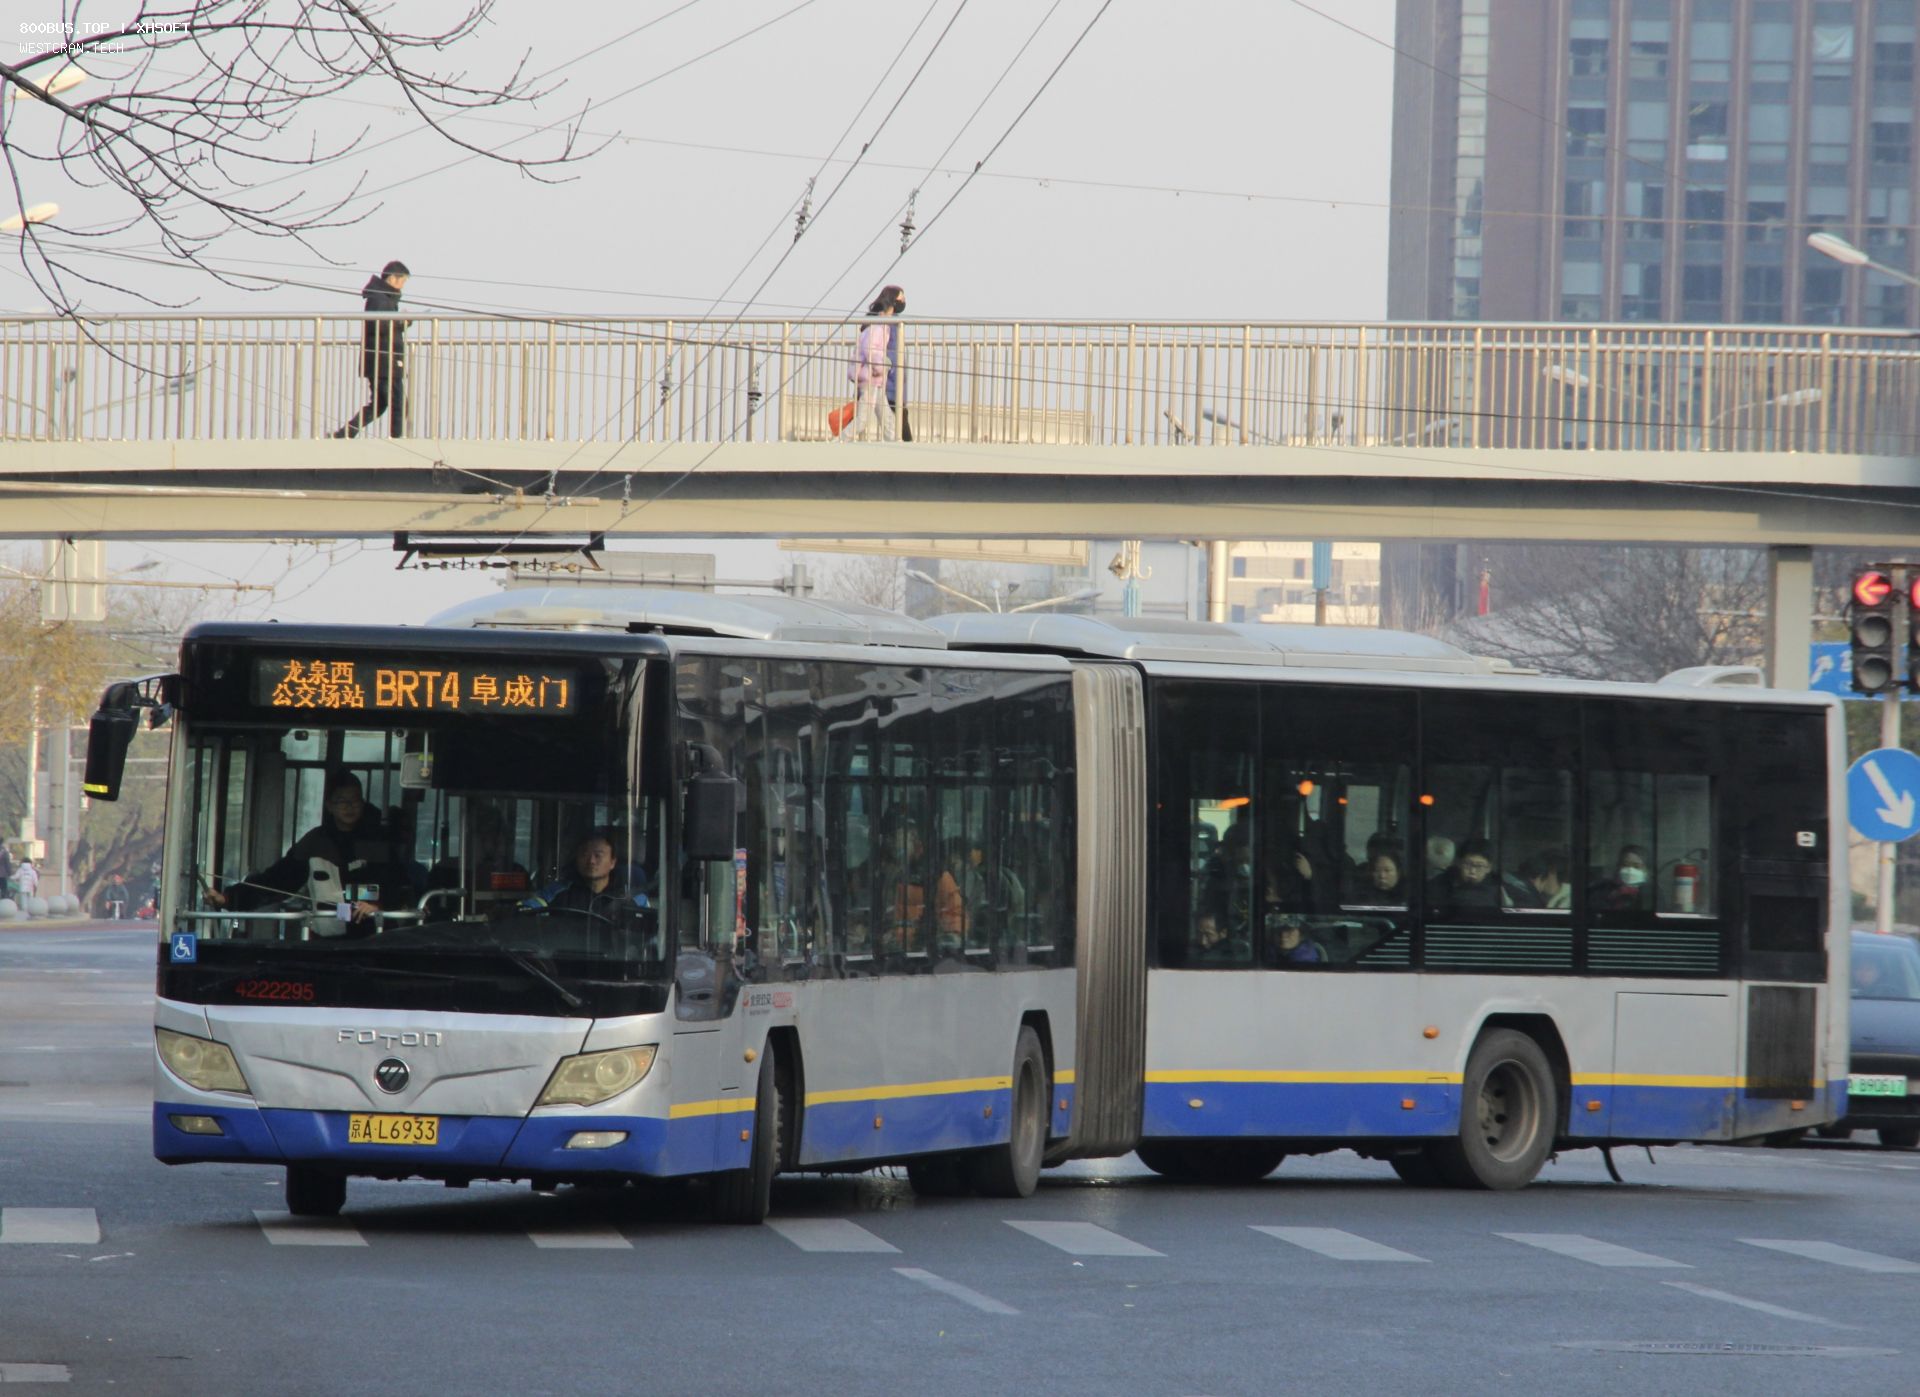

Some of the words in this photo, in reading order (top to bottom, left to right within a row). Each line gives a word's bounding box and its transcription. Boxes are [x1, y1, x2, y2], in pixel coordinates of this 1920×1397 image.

[283, 659, 354, 685] 龙泉西
[271, 683, 365, 709] 公交场站
[375, 669, 460, 709] BRT4
[469, 674, 567, 708] 阜成门
[235, 980, 315, 1001] 4222295
[337, 1028, 443, 1049] FOTON
